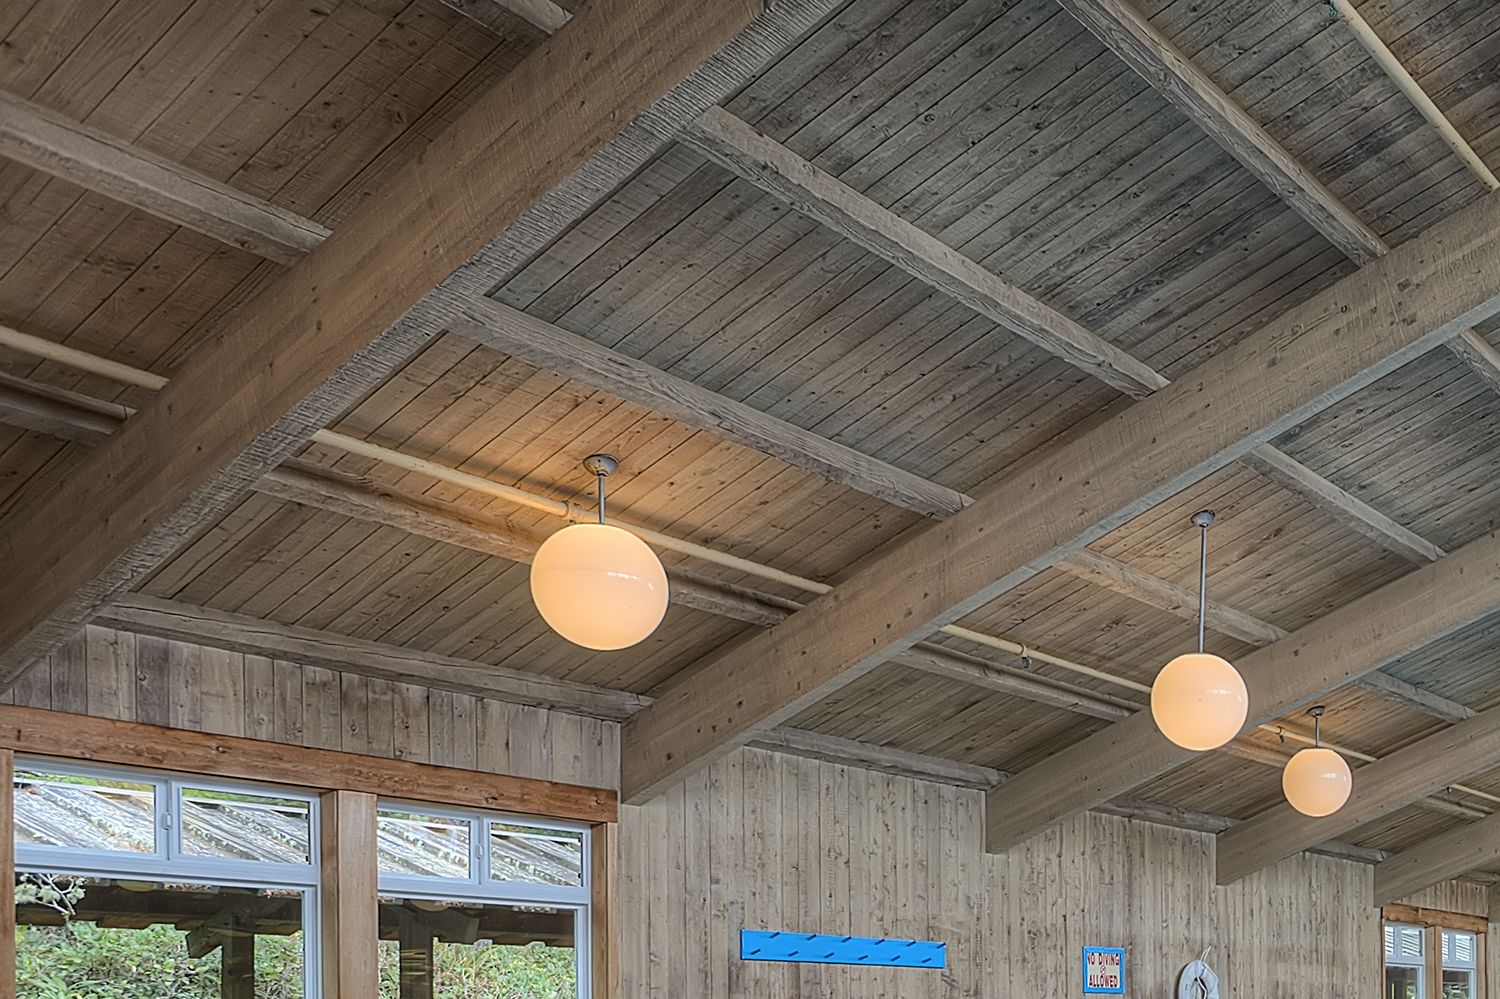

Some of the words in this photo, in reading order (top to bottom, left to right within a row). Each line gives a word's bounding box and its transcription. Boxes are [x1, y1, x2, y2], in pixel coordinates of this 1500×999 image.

[1087, 952, 1095, 965] NO
[1098, 953, 1120, 966] DIVING
[1089, 974, 1118, 988] ALLOWED
